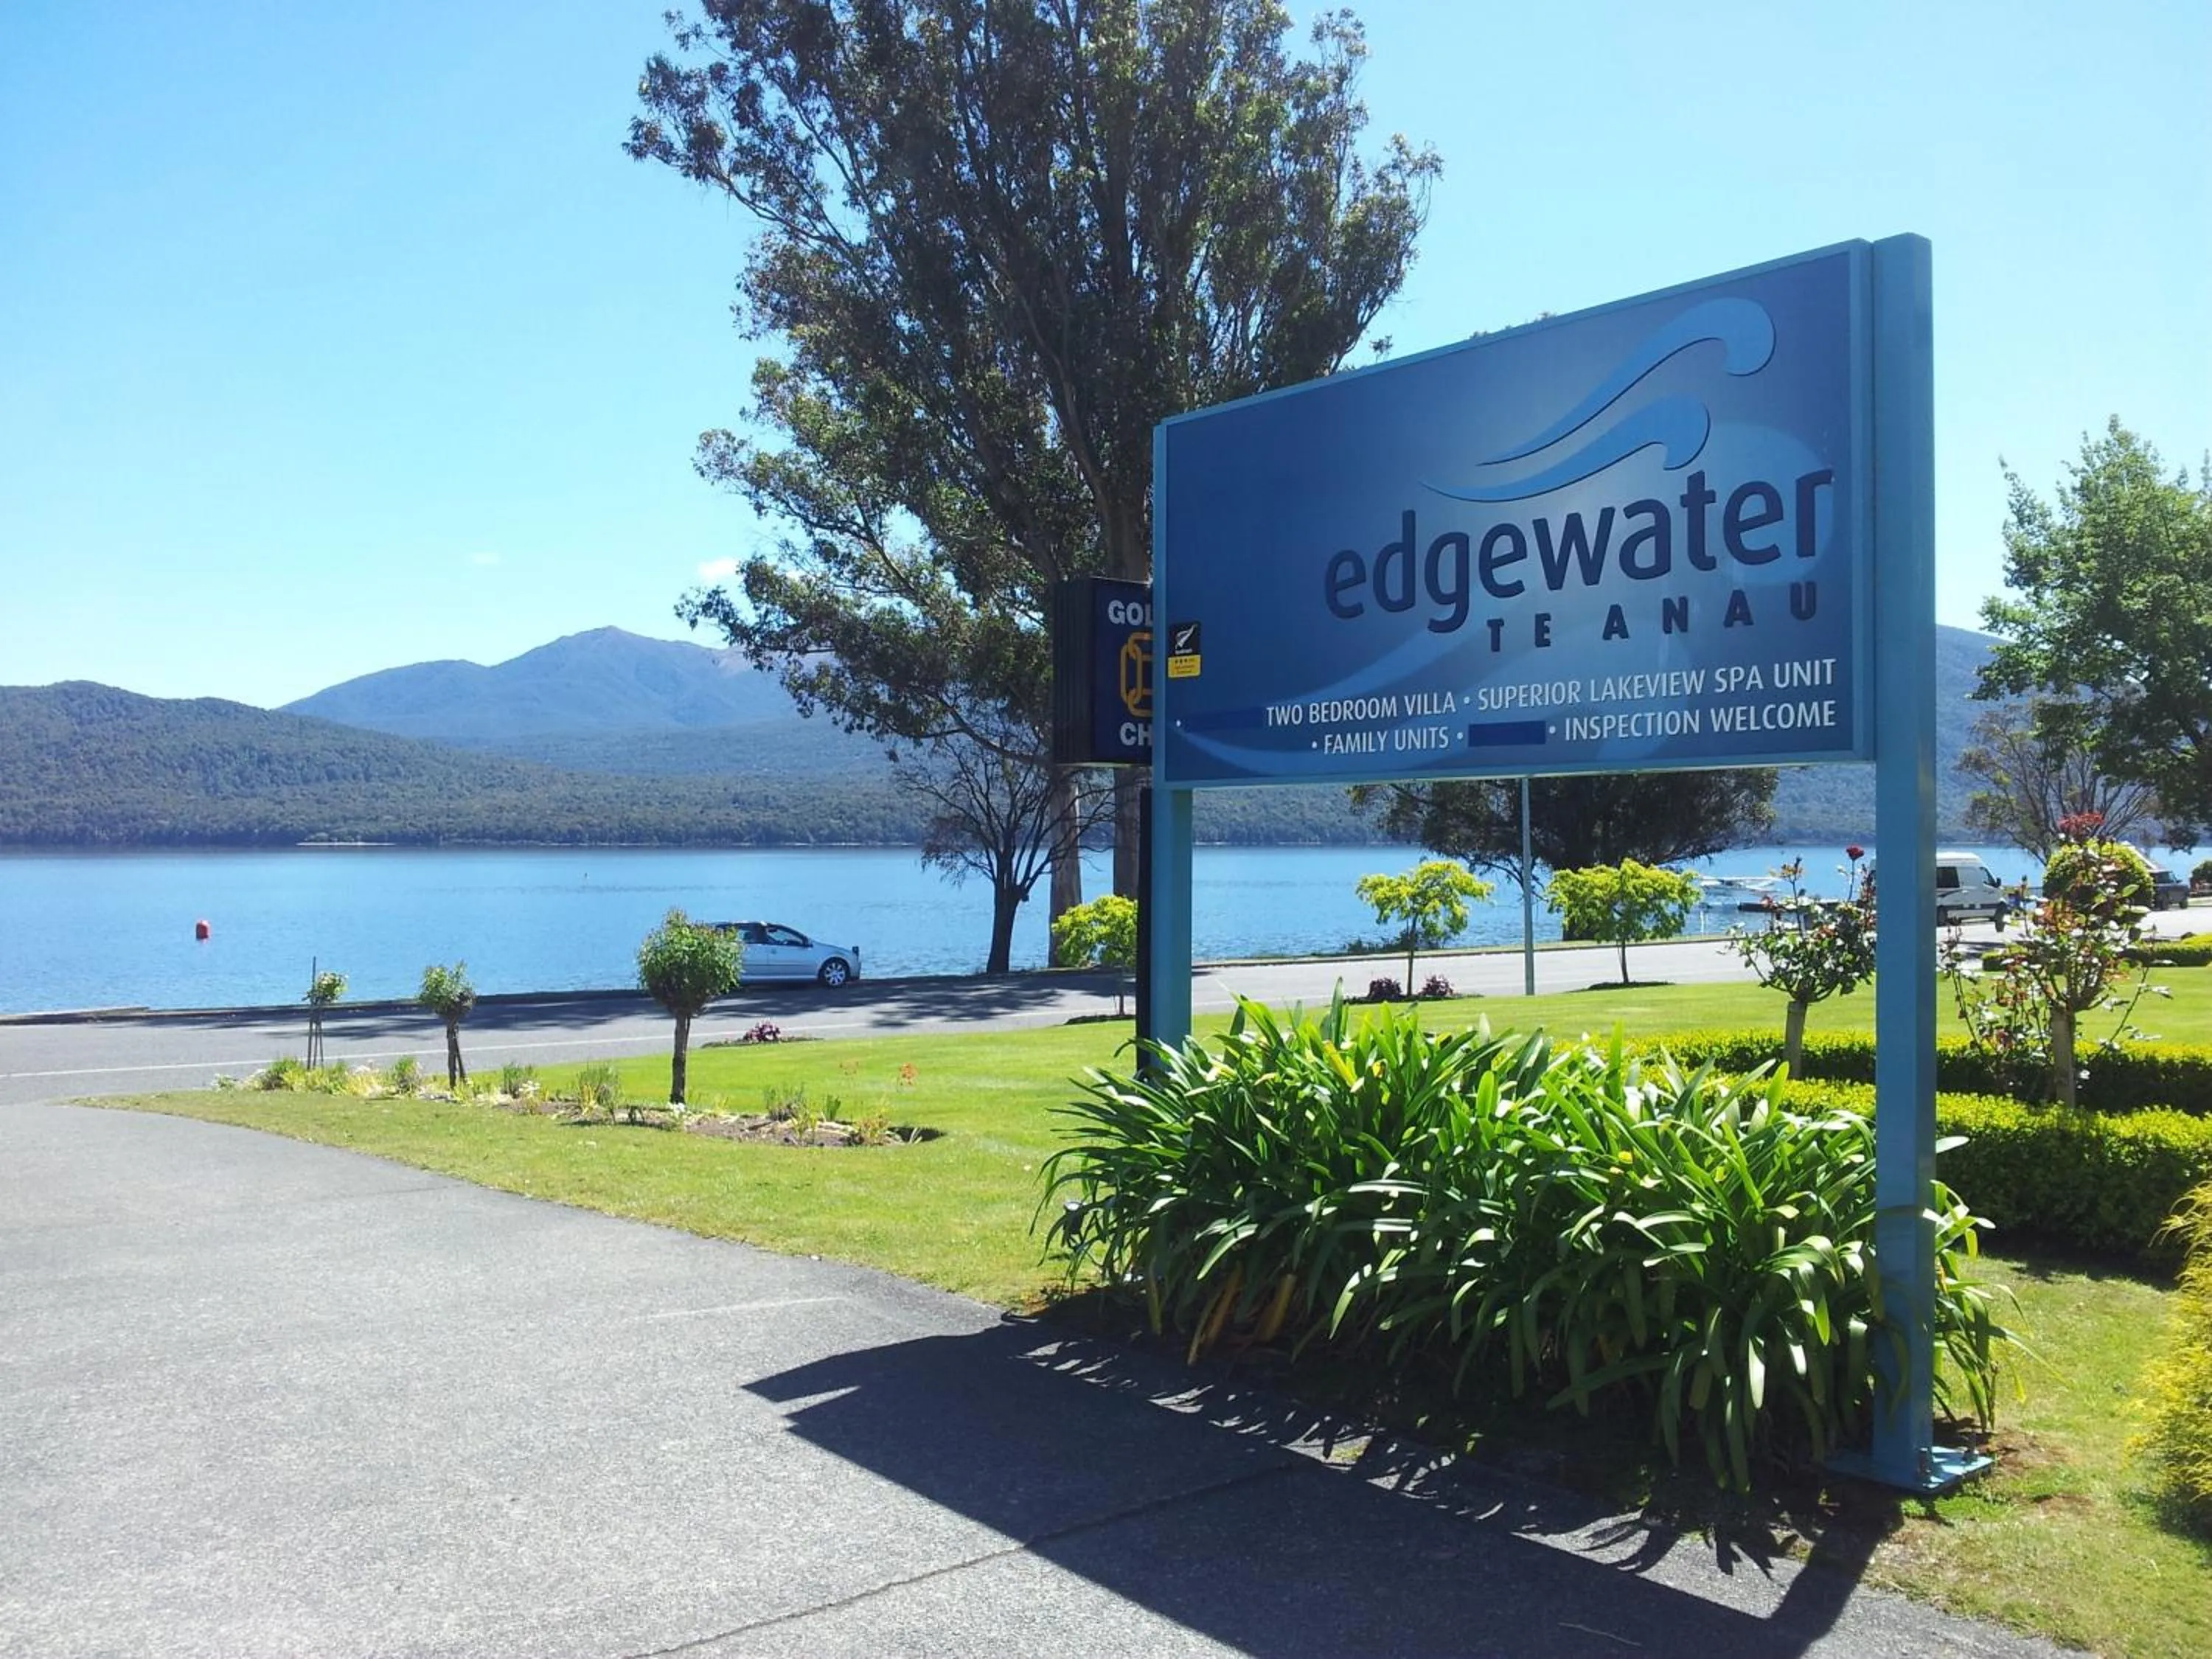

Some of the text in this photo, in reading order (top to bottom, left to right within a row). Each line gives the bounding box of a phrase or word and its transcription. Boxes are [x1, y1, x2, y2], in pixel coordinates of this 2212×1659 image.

[1325, 469, 1834, 633] edgewater
[1108, 599, 1152, 625] GOL
[1487, 582, 1817, 652] TE ANAU
[1266, 658, 1836, 726] TWO BEDROOM VILLA SUPERIOR LAKEVIEW SPA UNIT
[1324, 700, 1837, 754] FAMILY UNITS INSPECTION WELCOME
